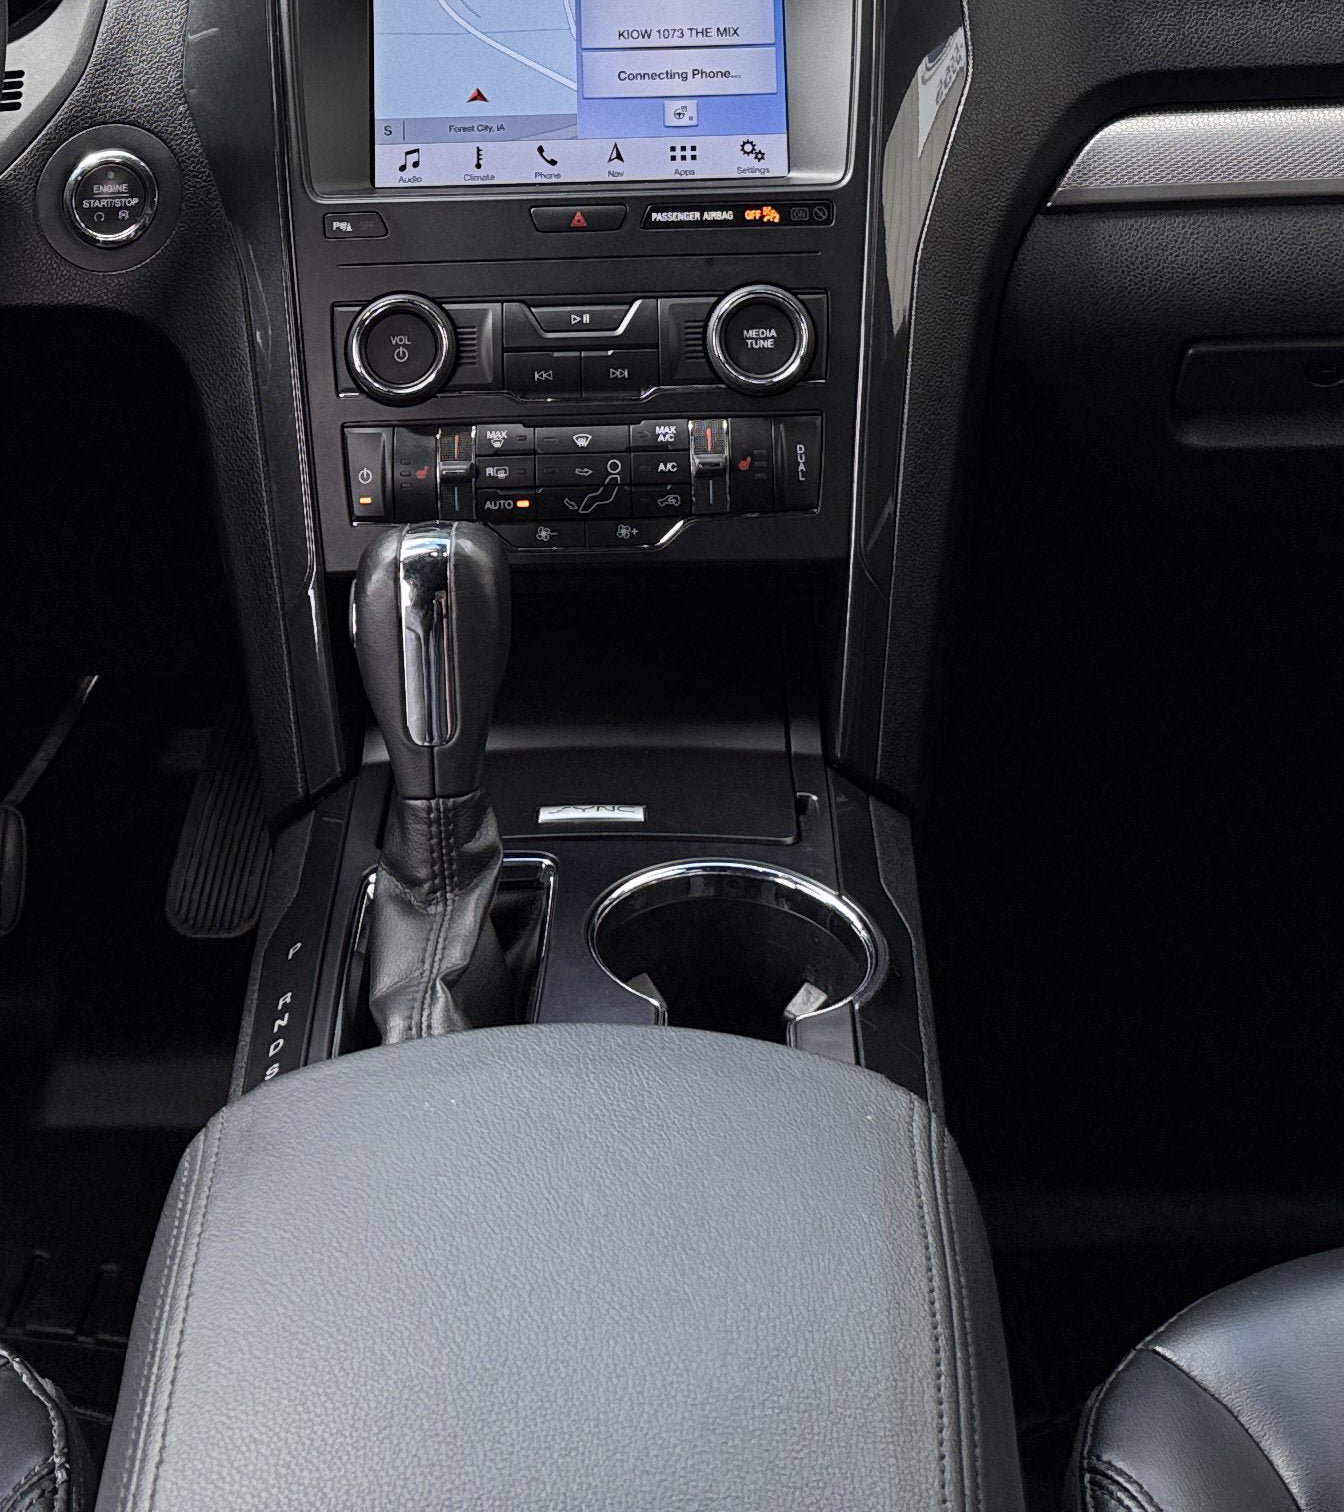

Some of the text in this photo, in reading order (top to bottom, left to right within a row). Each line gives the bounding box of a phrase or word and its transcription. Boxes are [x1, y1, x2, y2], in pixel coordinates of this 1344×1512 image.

[617, 26, 740, 40] KIOW 1073 THE MIX
[617, 69, 688, 82] Connecting
[383, 126, 393, 136] S
[448, 124, 475, 133] Forest
[607, 170, 625, 178] Nav
[674, 168, 696, 177] Apps
[736, 165, 771, 175] Settings
[398, 175, 423, 184] Audio
[463, 173, 496, 182] Climate
[534, 171, 562, 180] Phone
[93, 183, 129, 193] ENGINE
[82, 197, 140, 209] START/STOP
[651, 209, 762, 222] PASSENGER AIRBAG OFF
[742, 328, 778, 340] MEDIA
[390, 335, 412, 346] VOL
[745, 339, 776, 350] TUNE
[486, 430, 508, 439] MAX
[655, 426, 677, 434] MAX
[657, 434, 675, 442] A/C
[657, 462, 678, 473] A/C
[795, 444, 806, 481] DUAL
[484, 500, 513, 509] AUTO
[288, 942, 302, 961] P
[273, 1012, 289, 1033] N
[268, 1038, 284, 1058] D
[264, 1062, 280, 1082] S
